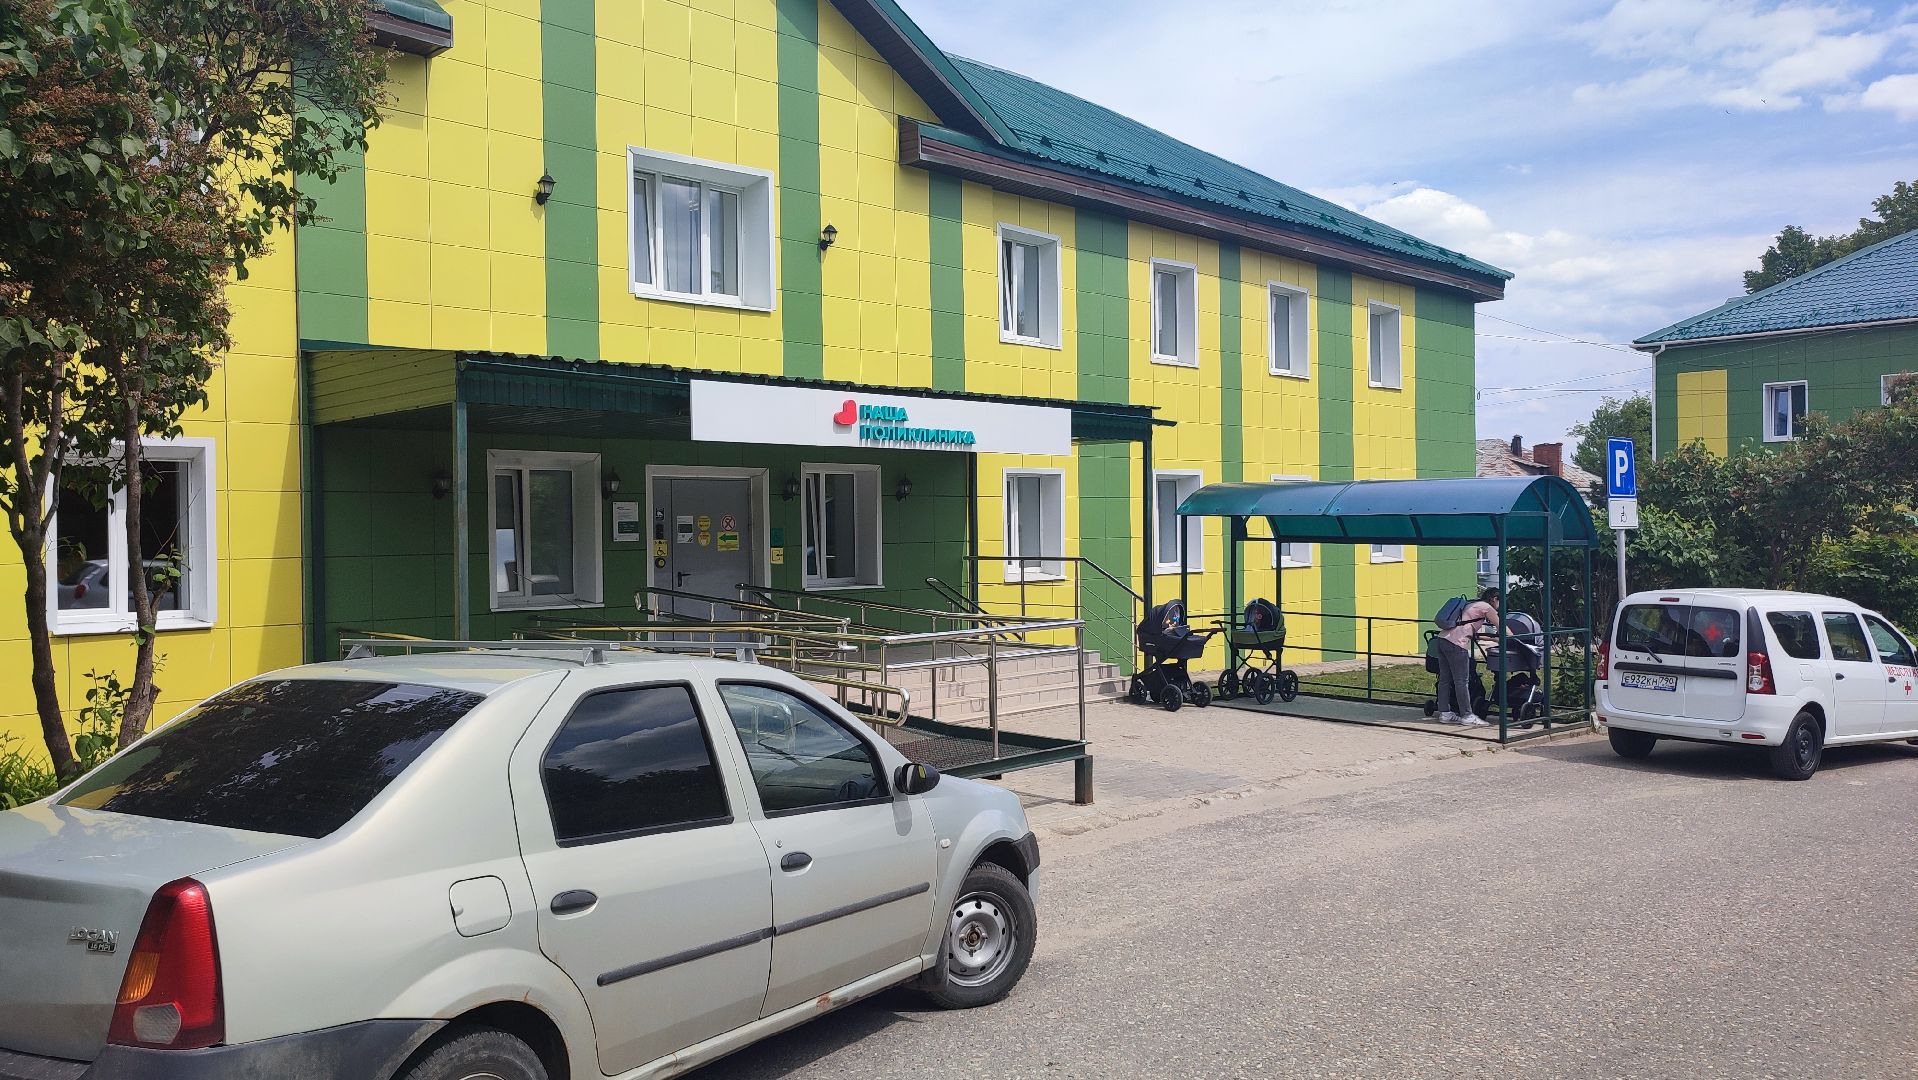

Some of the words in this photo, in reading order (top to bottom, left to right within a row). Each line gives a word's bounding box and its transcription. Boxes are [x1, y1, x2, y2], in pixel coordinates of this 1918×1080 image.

[859, 404, 909, 422] НАША
[859, 424, 976, 445] ПОЛИКЛИНИКА
[1615, 449, 1629, 488] P
[69, 926, 119, 943] LOGAN
